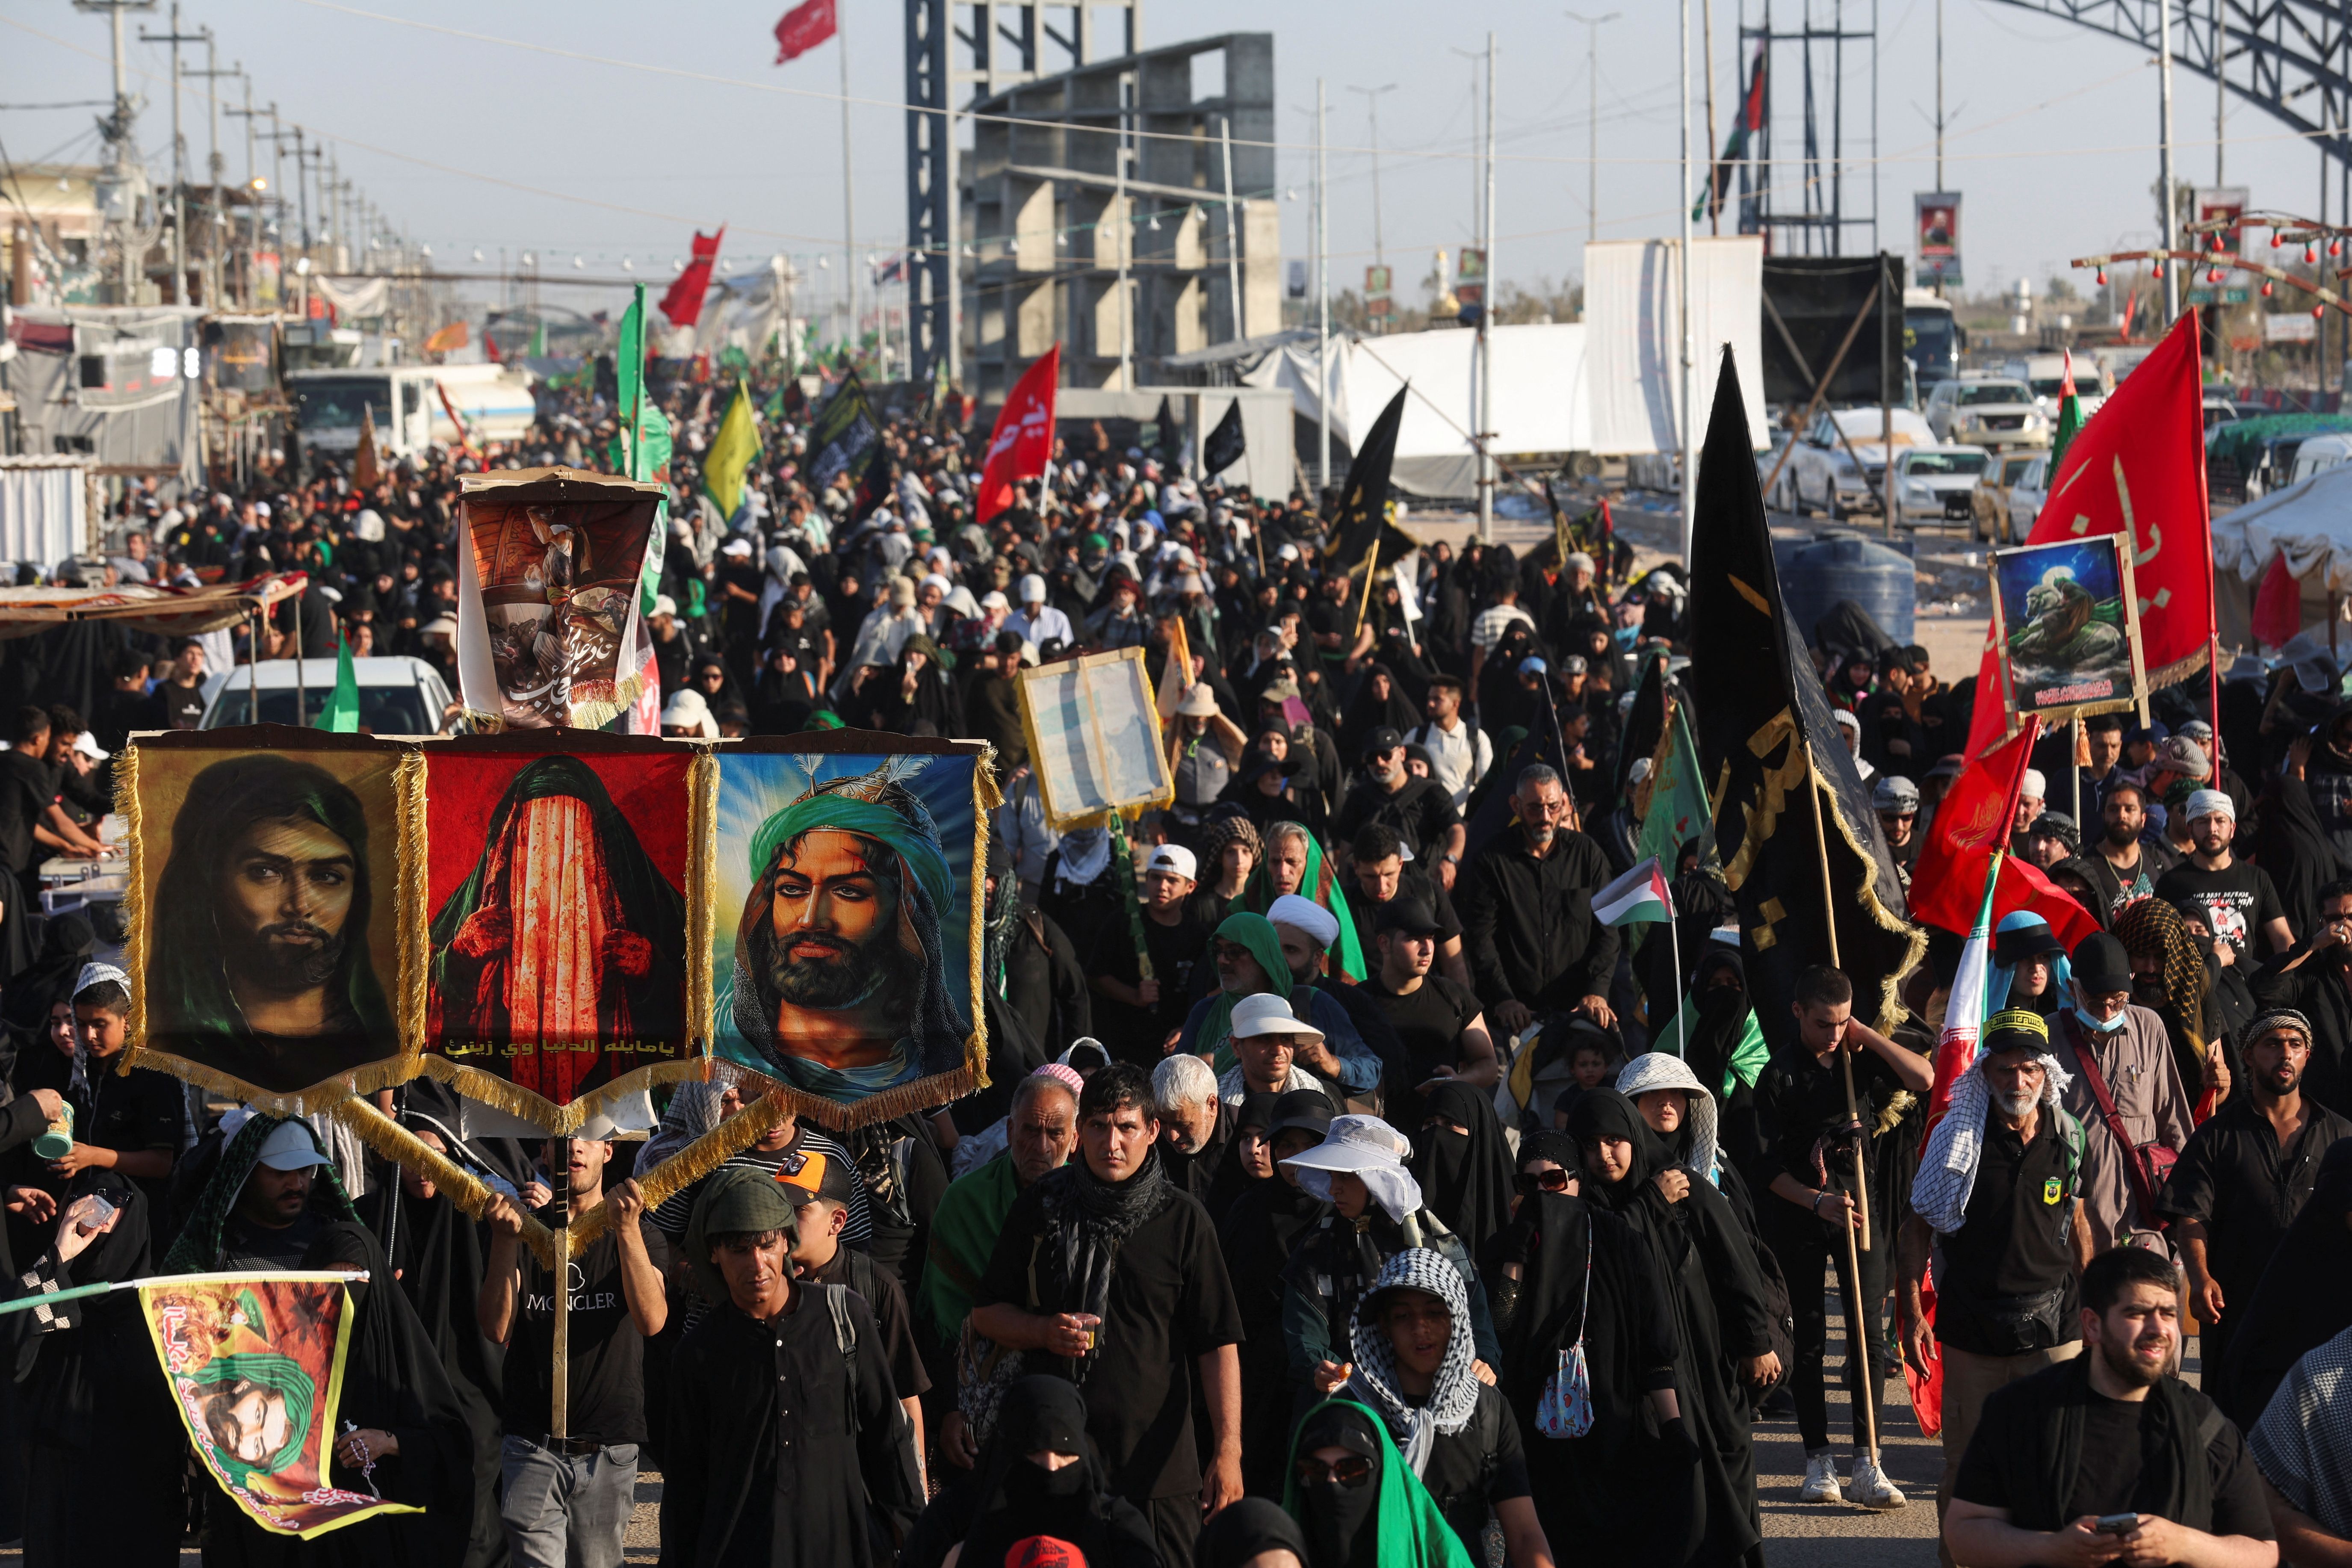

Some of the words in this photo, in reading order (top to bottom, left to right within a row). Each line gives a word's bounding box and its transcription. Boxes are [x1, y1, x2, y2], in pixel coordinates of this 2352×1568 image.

[2237, 896, 2254, 907] MEN
[445, 1041, 493, 1058] زينب
[542, 1039, 595, 1053] الدنيا
